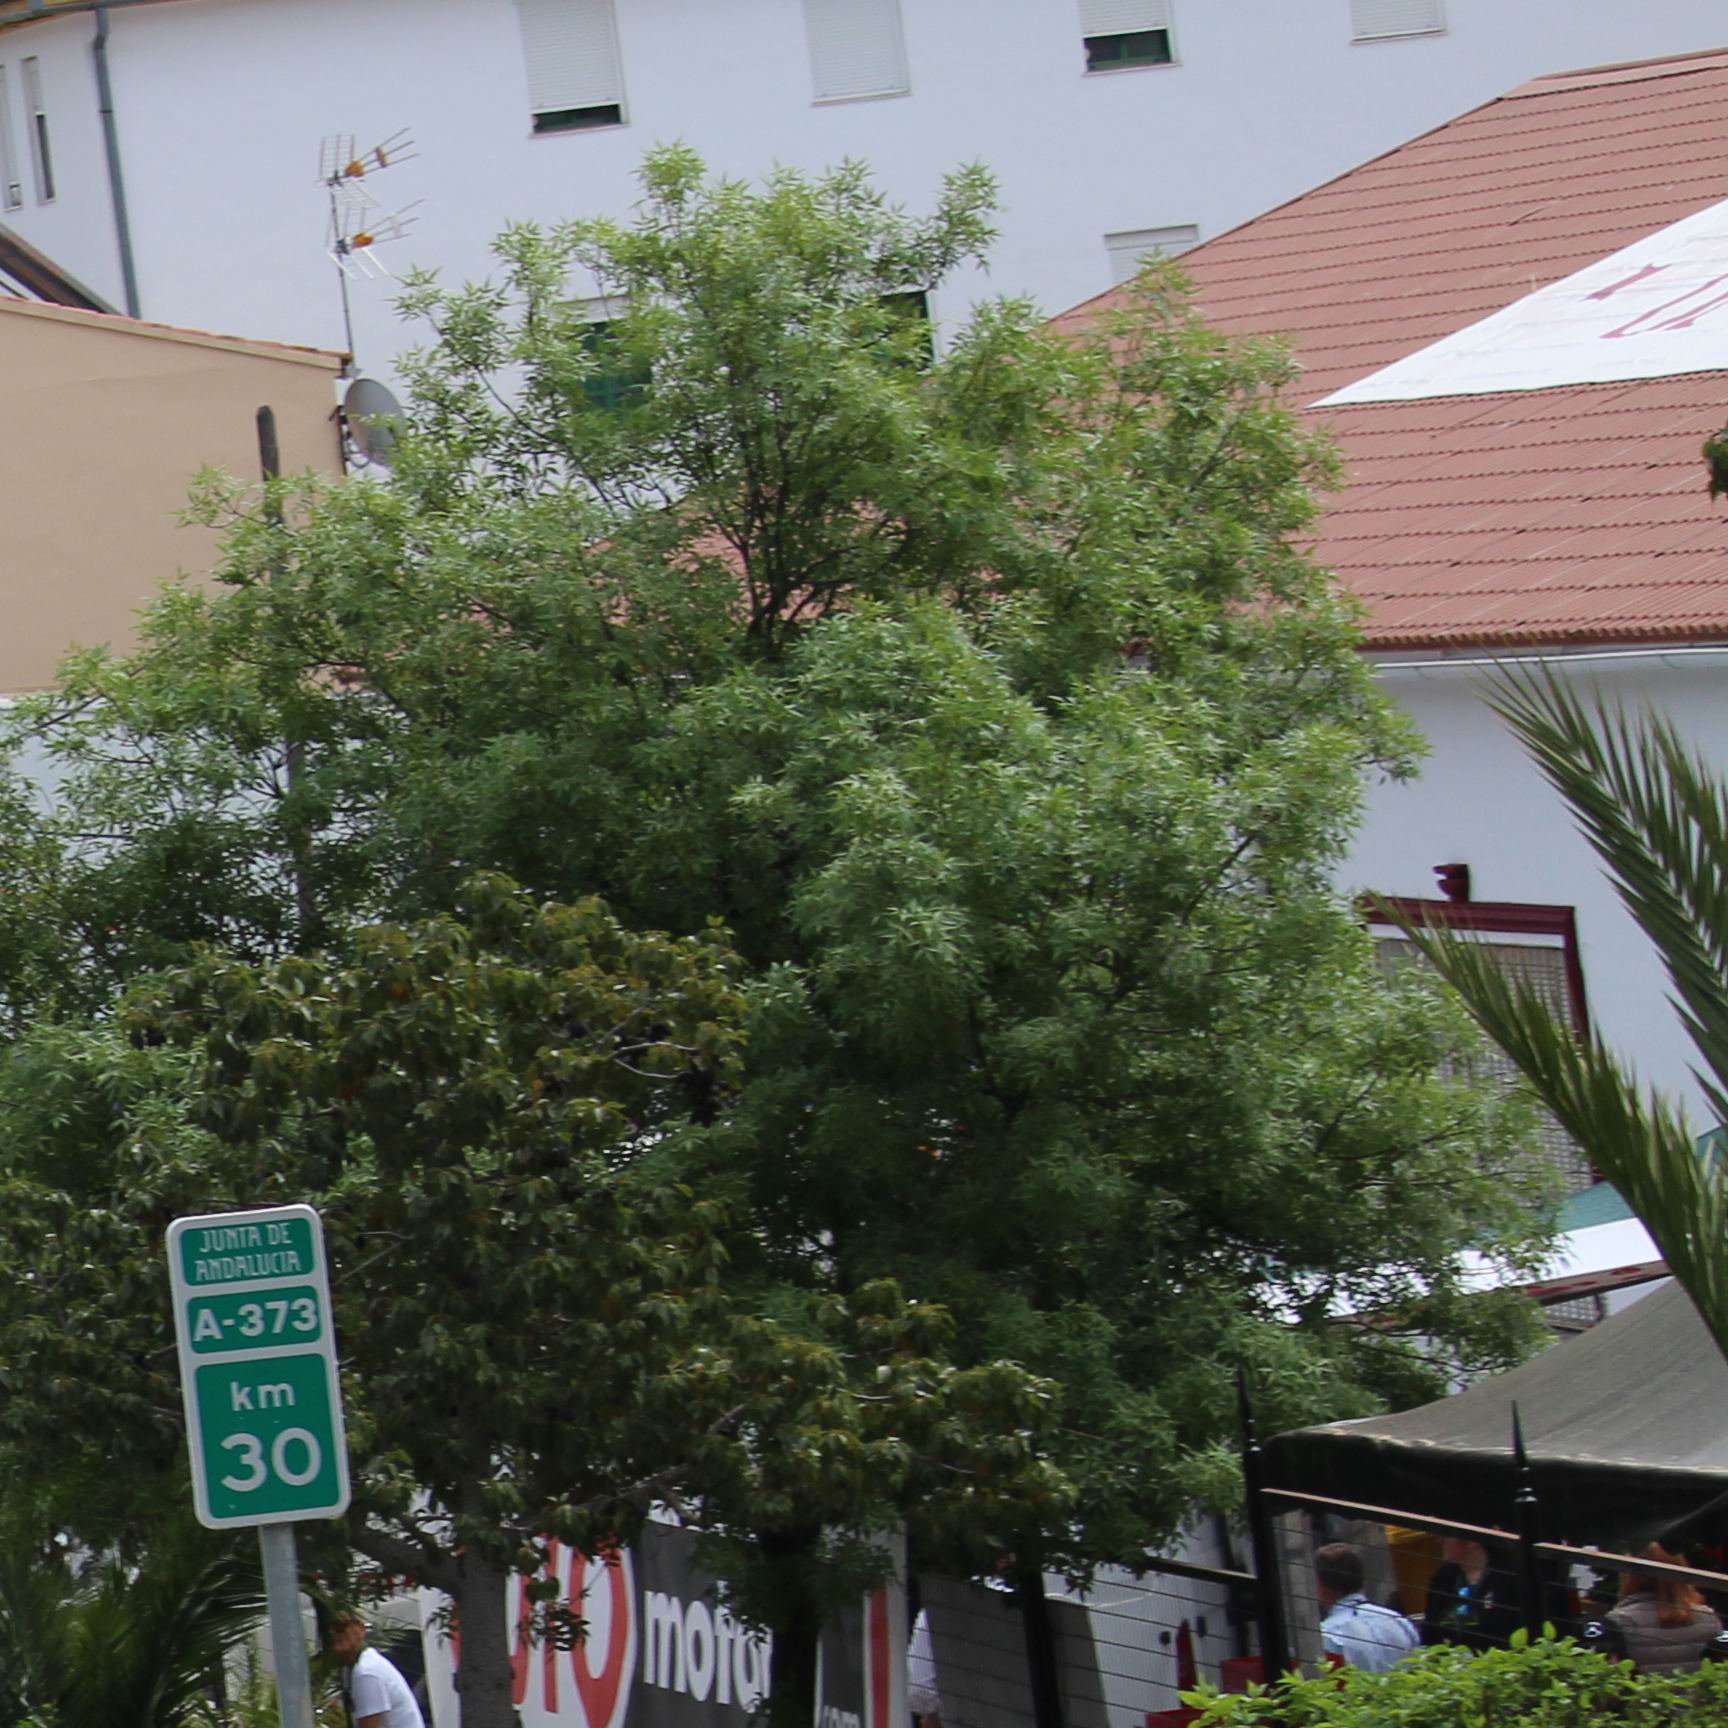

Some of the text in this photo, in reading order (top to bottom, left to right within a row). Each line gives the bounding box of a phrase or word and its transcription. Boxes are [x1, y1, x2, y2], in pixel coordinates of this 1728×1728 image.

[199, 1222, 293, 1253] JUNTA DE
[193, 1297, 319, 1342] A-373
[229, 1380, 296, 1412] km
[220, 1427, 322, 1493] 30
